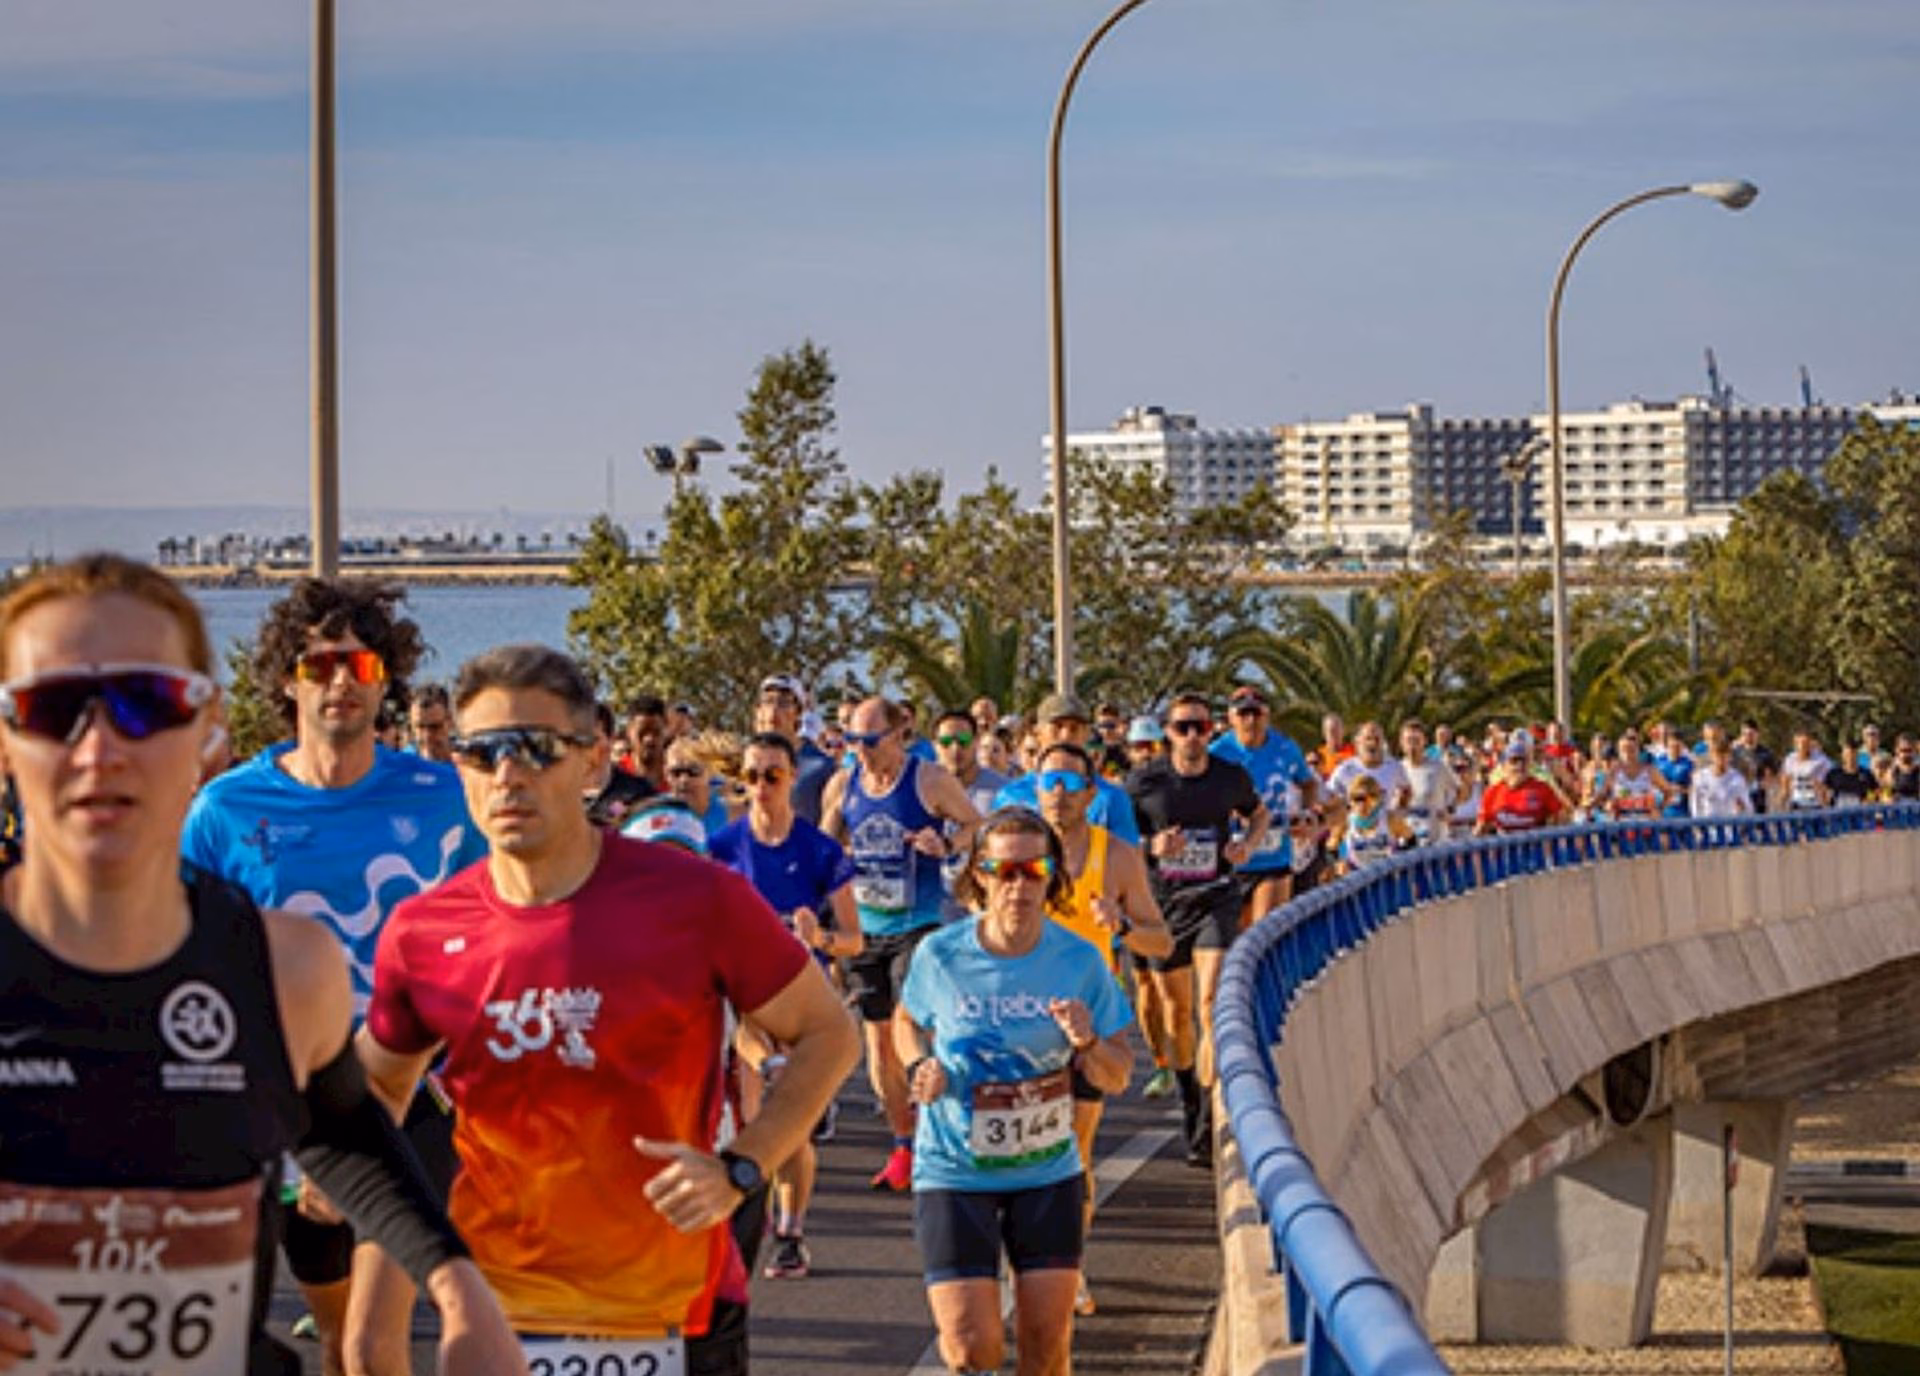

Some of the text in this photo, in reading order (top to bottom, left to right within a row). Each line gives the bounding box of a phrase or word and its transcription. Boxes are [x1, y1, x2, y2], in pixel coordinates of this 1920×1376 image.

[986, 1107, 1060, 1144] 3144
[73, 1239, 168, 1273] 10K
[21, 1293, 214, 1360] 736
